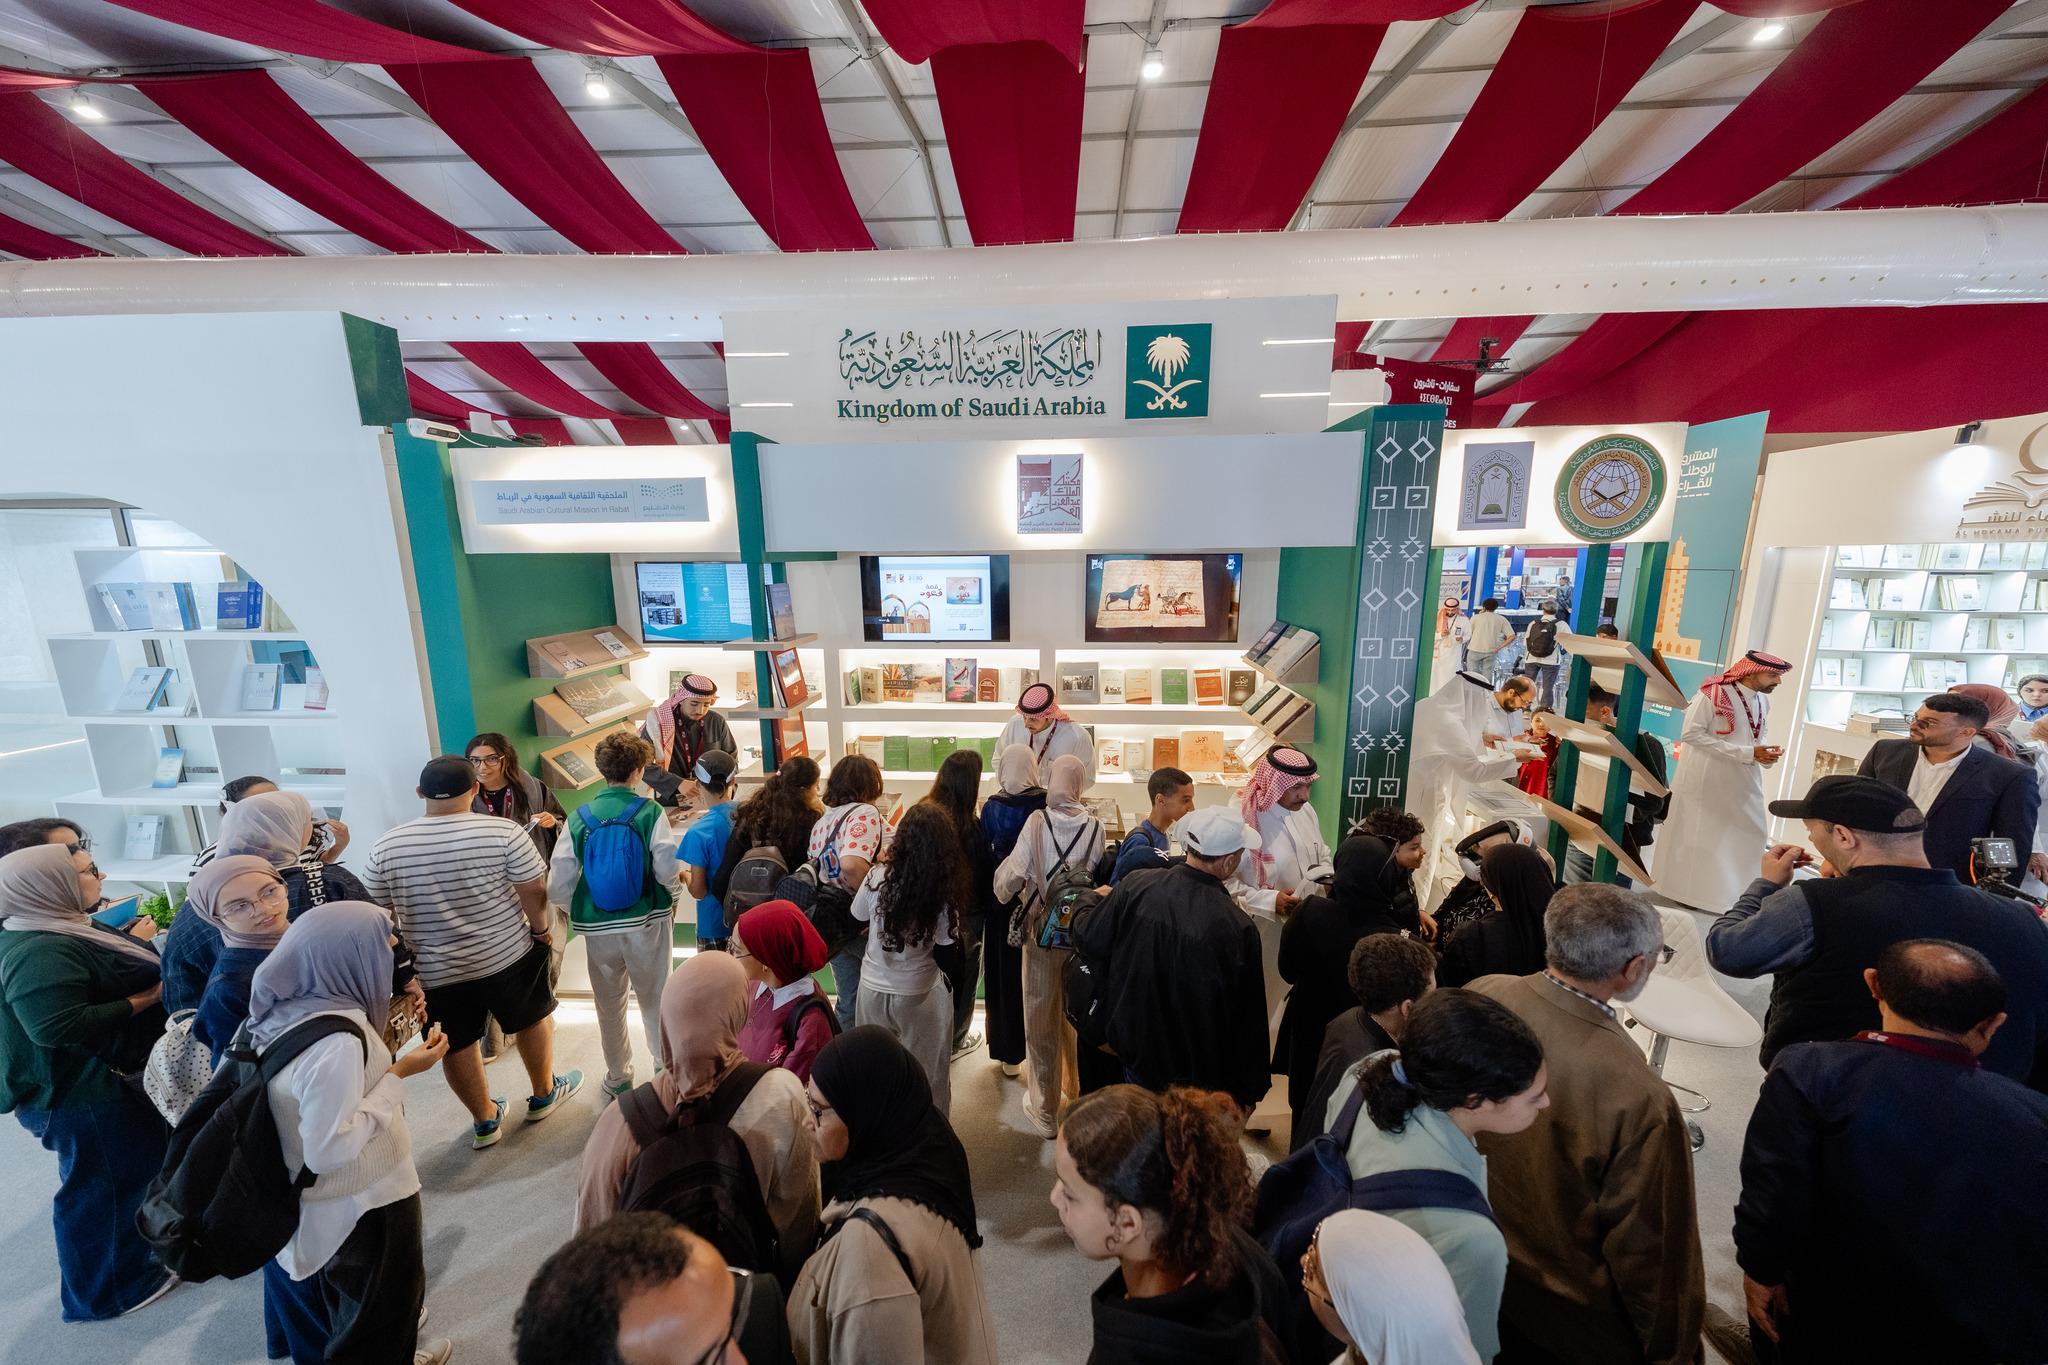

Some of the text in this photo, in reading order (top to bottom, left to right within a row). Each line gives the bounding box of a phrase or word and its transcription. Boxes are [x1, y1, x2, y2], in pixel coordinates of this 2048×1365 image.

[838, 328, 1102, 389] المملكة العربية السعودية
[837, 395, 1106, 423] Kingdom of Saudi Arabia
[1681, 448, 1718, 465] المشرو
[496, 492, 519, 502] الرباط
[521, 494, 533, 503] في
[534, 492, 567, 502] السعودية
[597, 491, 628, 500] الملحقية
[498, 506, 518, 514] Saudi
[519, 506, 545, 514] Arabian
[546, 506, 572, 514] Cultural
[573, 505, 600, 513] Mission
[609, 505, 630, 513] Rabat
